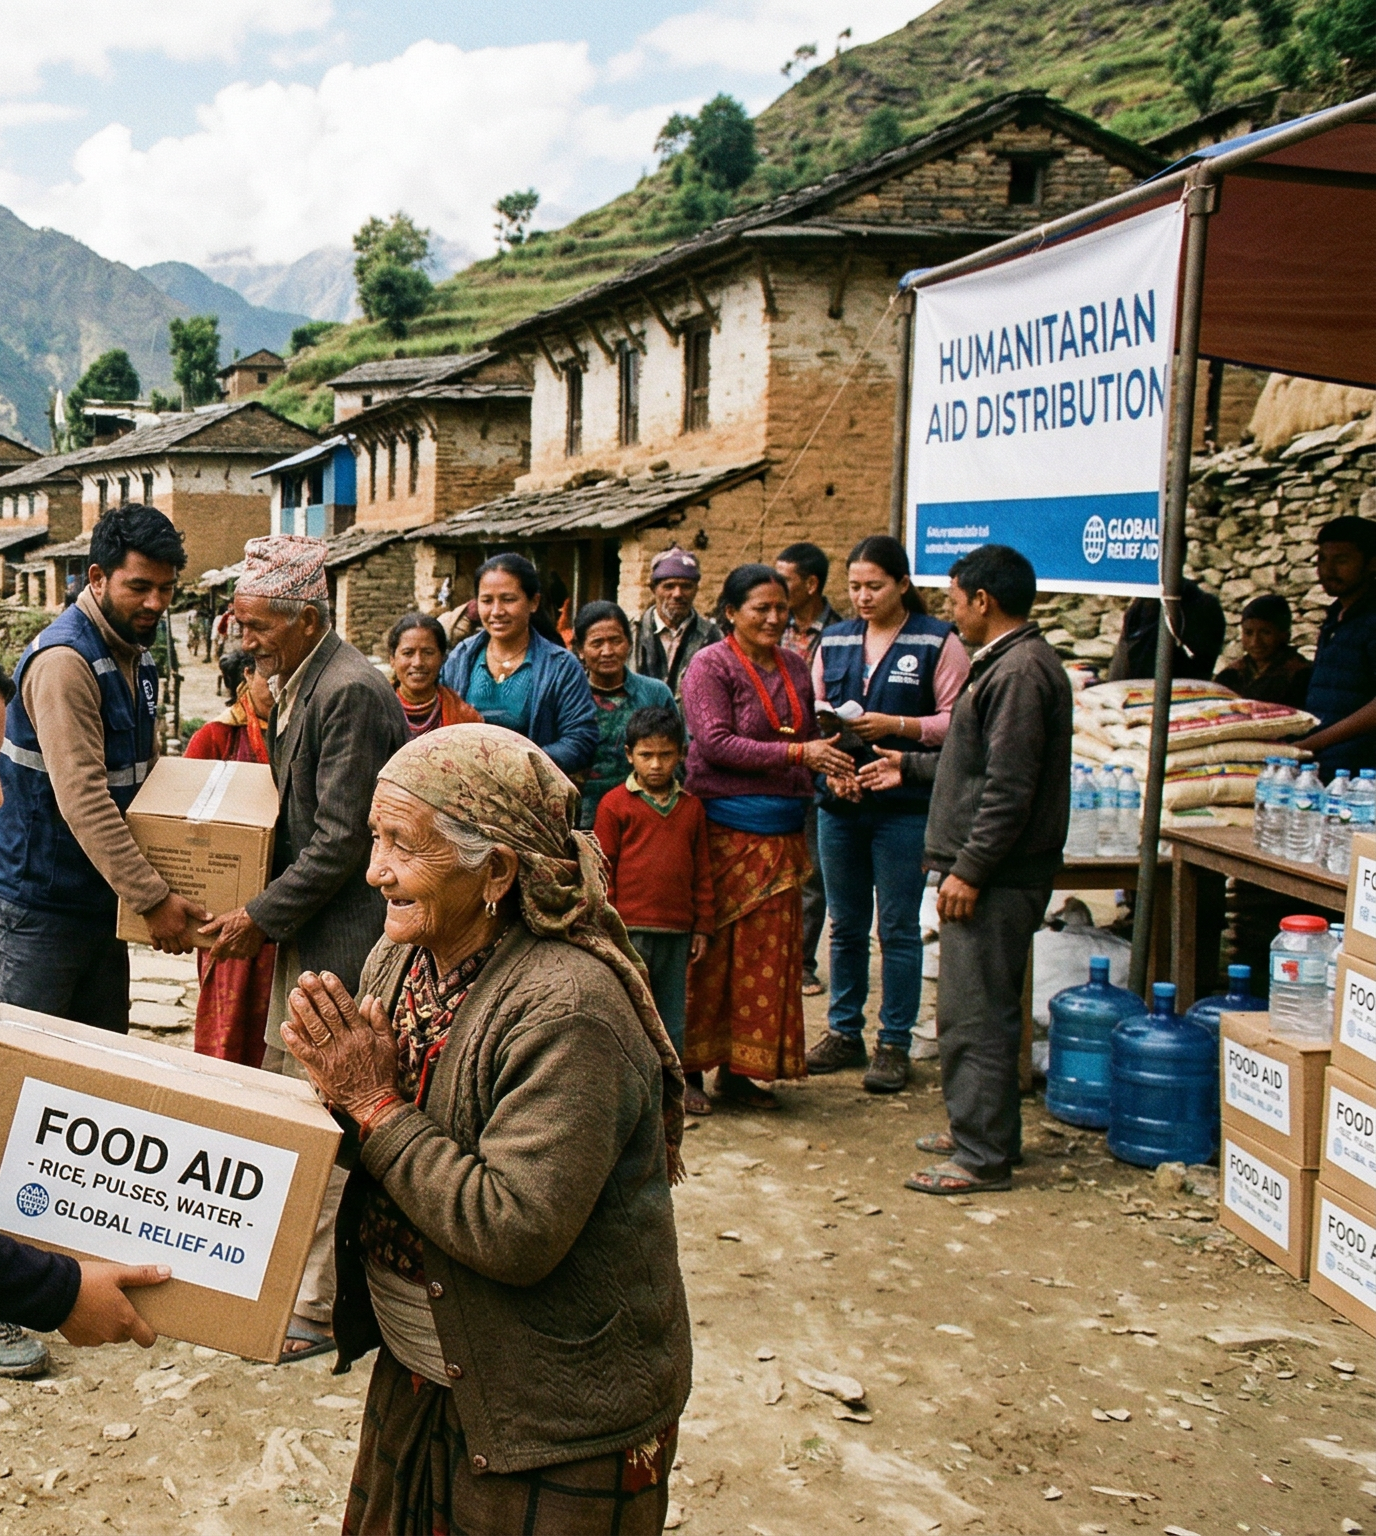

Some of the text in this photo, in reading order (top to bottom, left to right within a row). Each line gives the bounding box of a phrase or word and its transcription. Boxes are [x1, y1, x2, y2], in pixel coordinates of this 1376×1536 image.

[940, 289, 1155, 384] HUMANITARIAN
[926, 363, 1167, 444] AID DISTRIBUTION
[1107, 542, 1159, 560] RELIEF AID
[1108, 518, 1159, 540] GLOBAL
[1229, 1049, 1259, 1078] FOOD
[1262, 1067, 1282, 1089] AID
[1337, 1101, 1373, 1136] FOOD
[35, 1106, 264, 1201] FOOD AID
[1230, 1153, 1259, 1186] FOOD
[1262, 1175, 1282, 1200] AID
[39, 1158, 86, 1188] RICE,
[92, 1173, 169, 1212] PULSES,
[177, 1196, 242, 1228] WATER
[54, 1199, 245, 1264] GLOBAL RELIEF AID
[1328, 1214, 1366, 1253] FOOD
